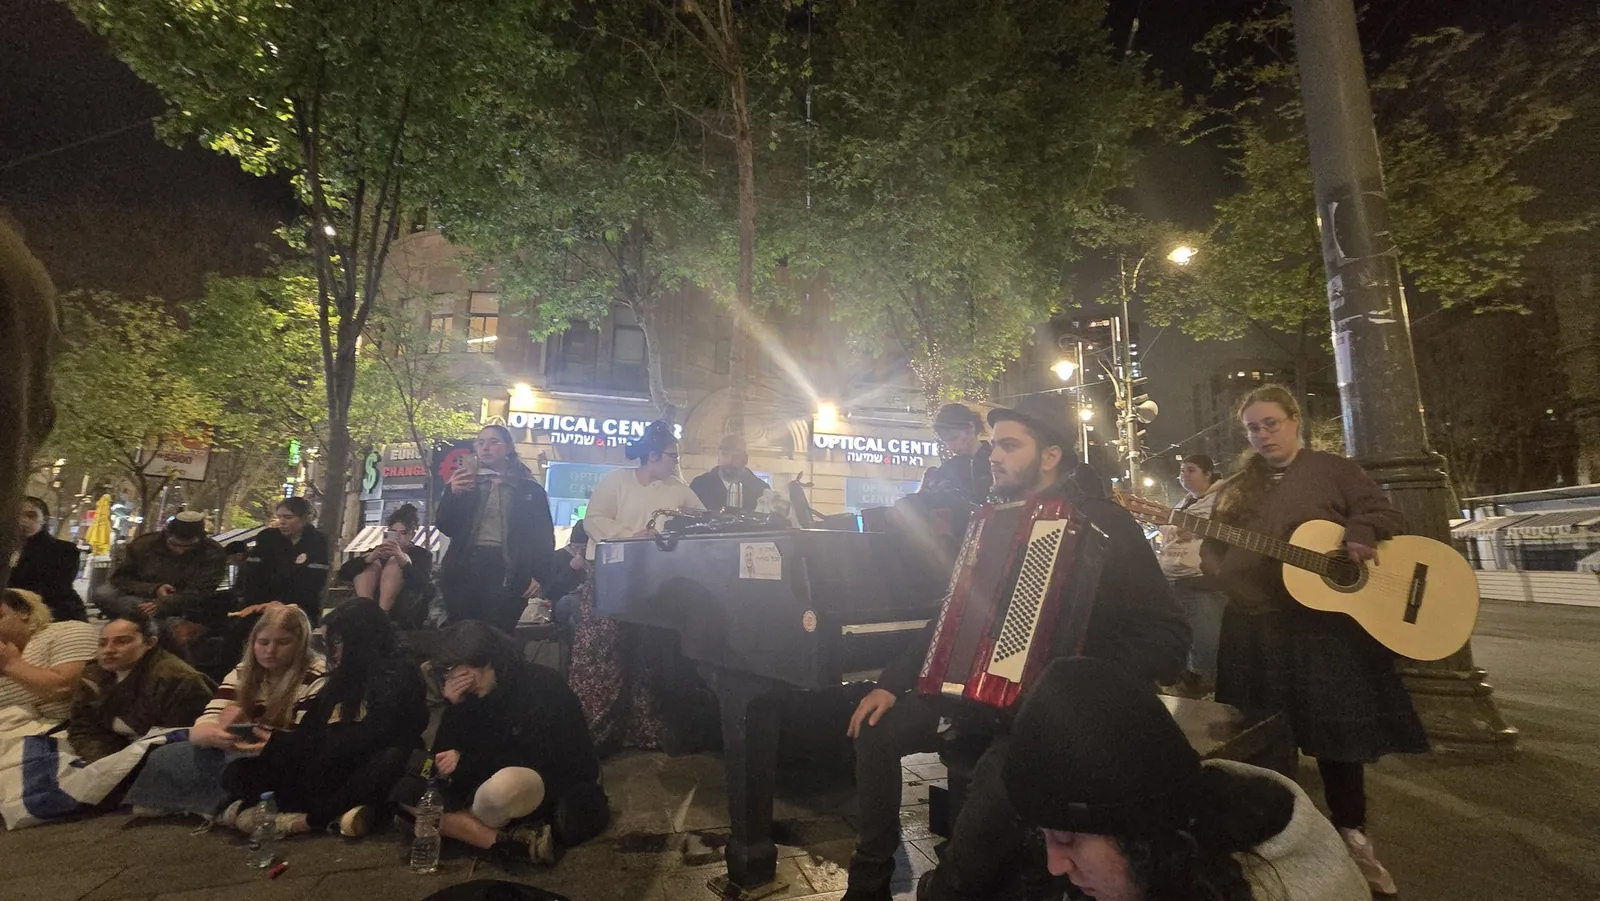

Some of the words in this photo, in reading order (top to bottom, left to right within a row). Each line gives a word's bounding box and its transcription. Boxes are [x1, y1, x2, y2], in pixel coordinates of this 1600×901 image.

[510, 412, 599, 434] OPTICAL
[602, 419, 683, 439] CENR
[551, 432, 595, 446] שמיעה
[606, 435, 632, 447] ייה
[815, 435, 886, 452] OPTICAL
[887, 439, 939, 456] CENTE
[847, 452, 883, 463] שמיעה
[892, 455, 924, 466] ראייה
[570, 471, 608, 483] OPTIC
[569, 484, 596, 493] CEN
[862, 483, 904, 495] OPAL
[862, 494, 896, 505] CENTE
